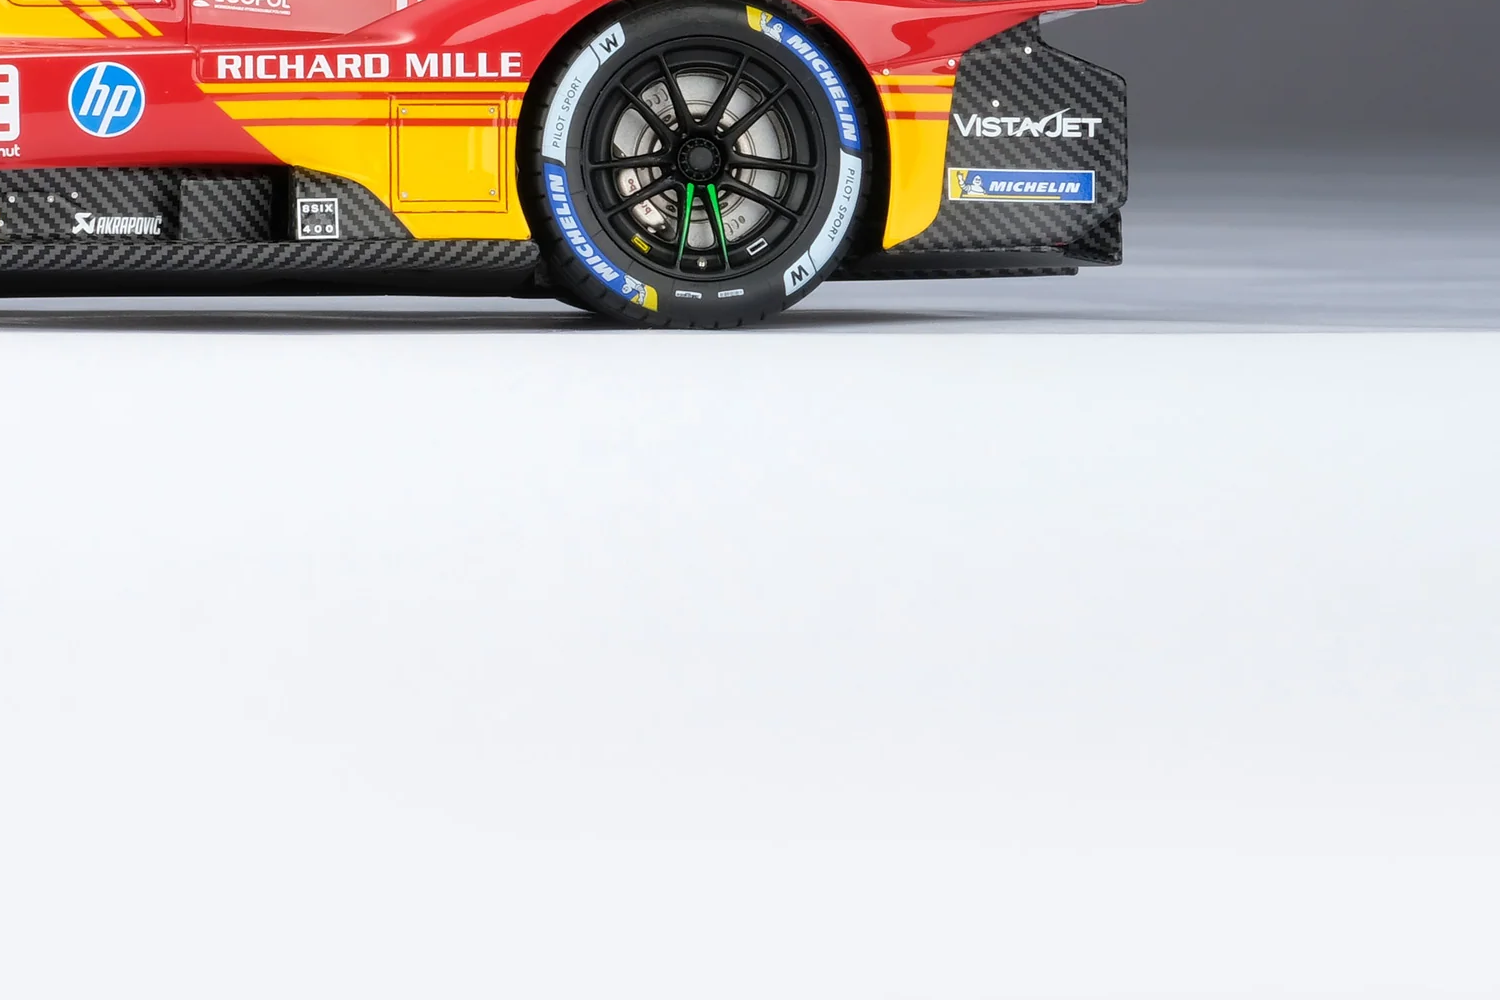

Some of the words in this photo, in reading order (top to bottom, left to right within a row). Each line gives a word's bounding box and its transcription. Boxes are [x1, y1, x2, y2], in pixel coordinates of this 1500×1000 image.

[599, 33, 619, 54] W
[217, 54, 389, 79] RICHARD
[406, 52, 522, 78] MILLE
[80, 64, 136, 135] hp
[786, 34, 858, 142] MICHELIN
[552, 116, 566, 149] PILOT
[561, 76, 582, 112] SPORT
[844, 167, 855, 202] PILOT
[989, 181, 1081, 193] MICHELIN
[302, 204, 334, 213] 8SIX
[828, 204, 847, 242] SPORT
[302, 224, 334, 234] 400
[548, 174, 620, 282] MICHELIN
[790, 264, 809, 287] W
